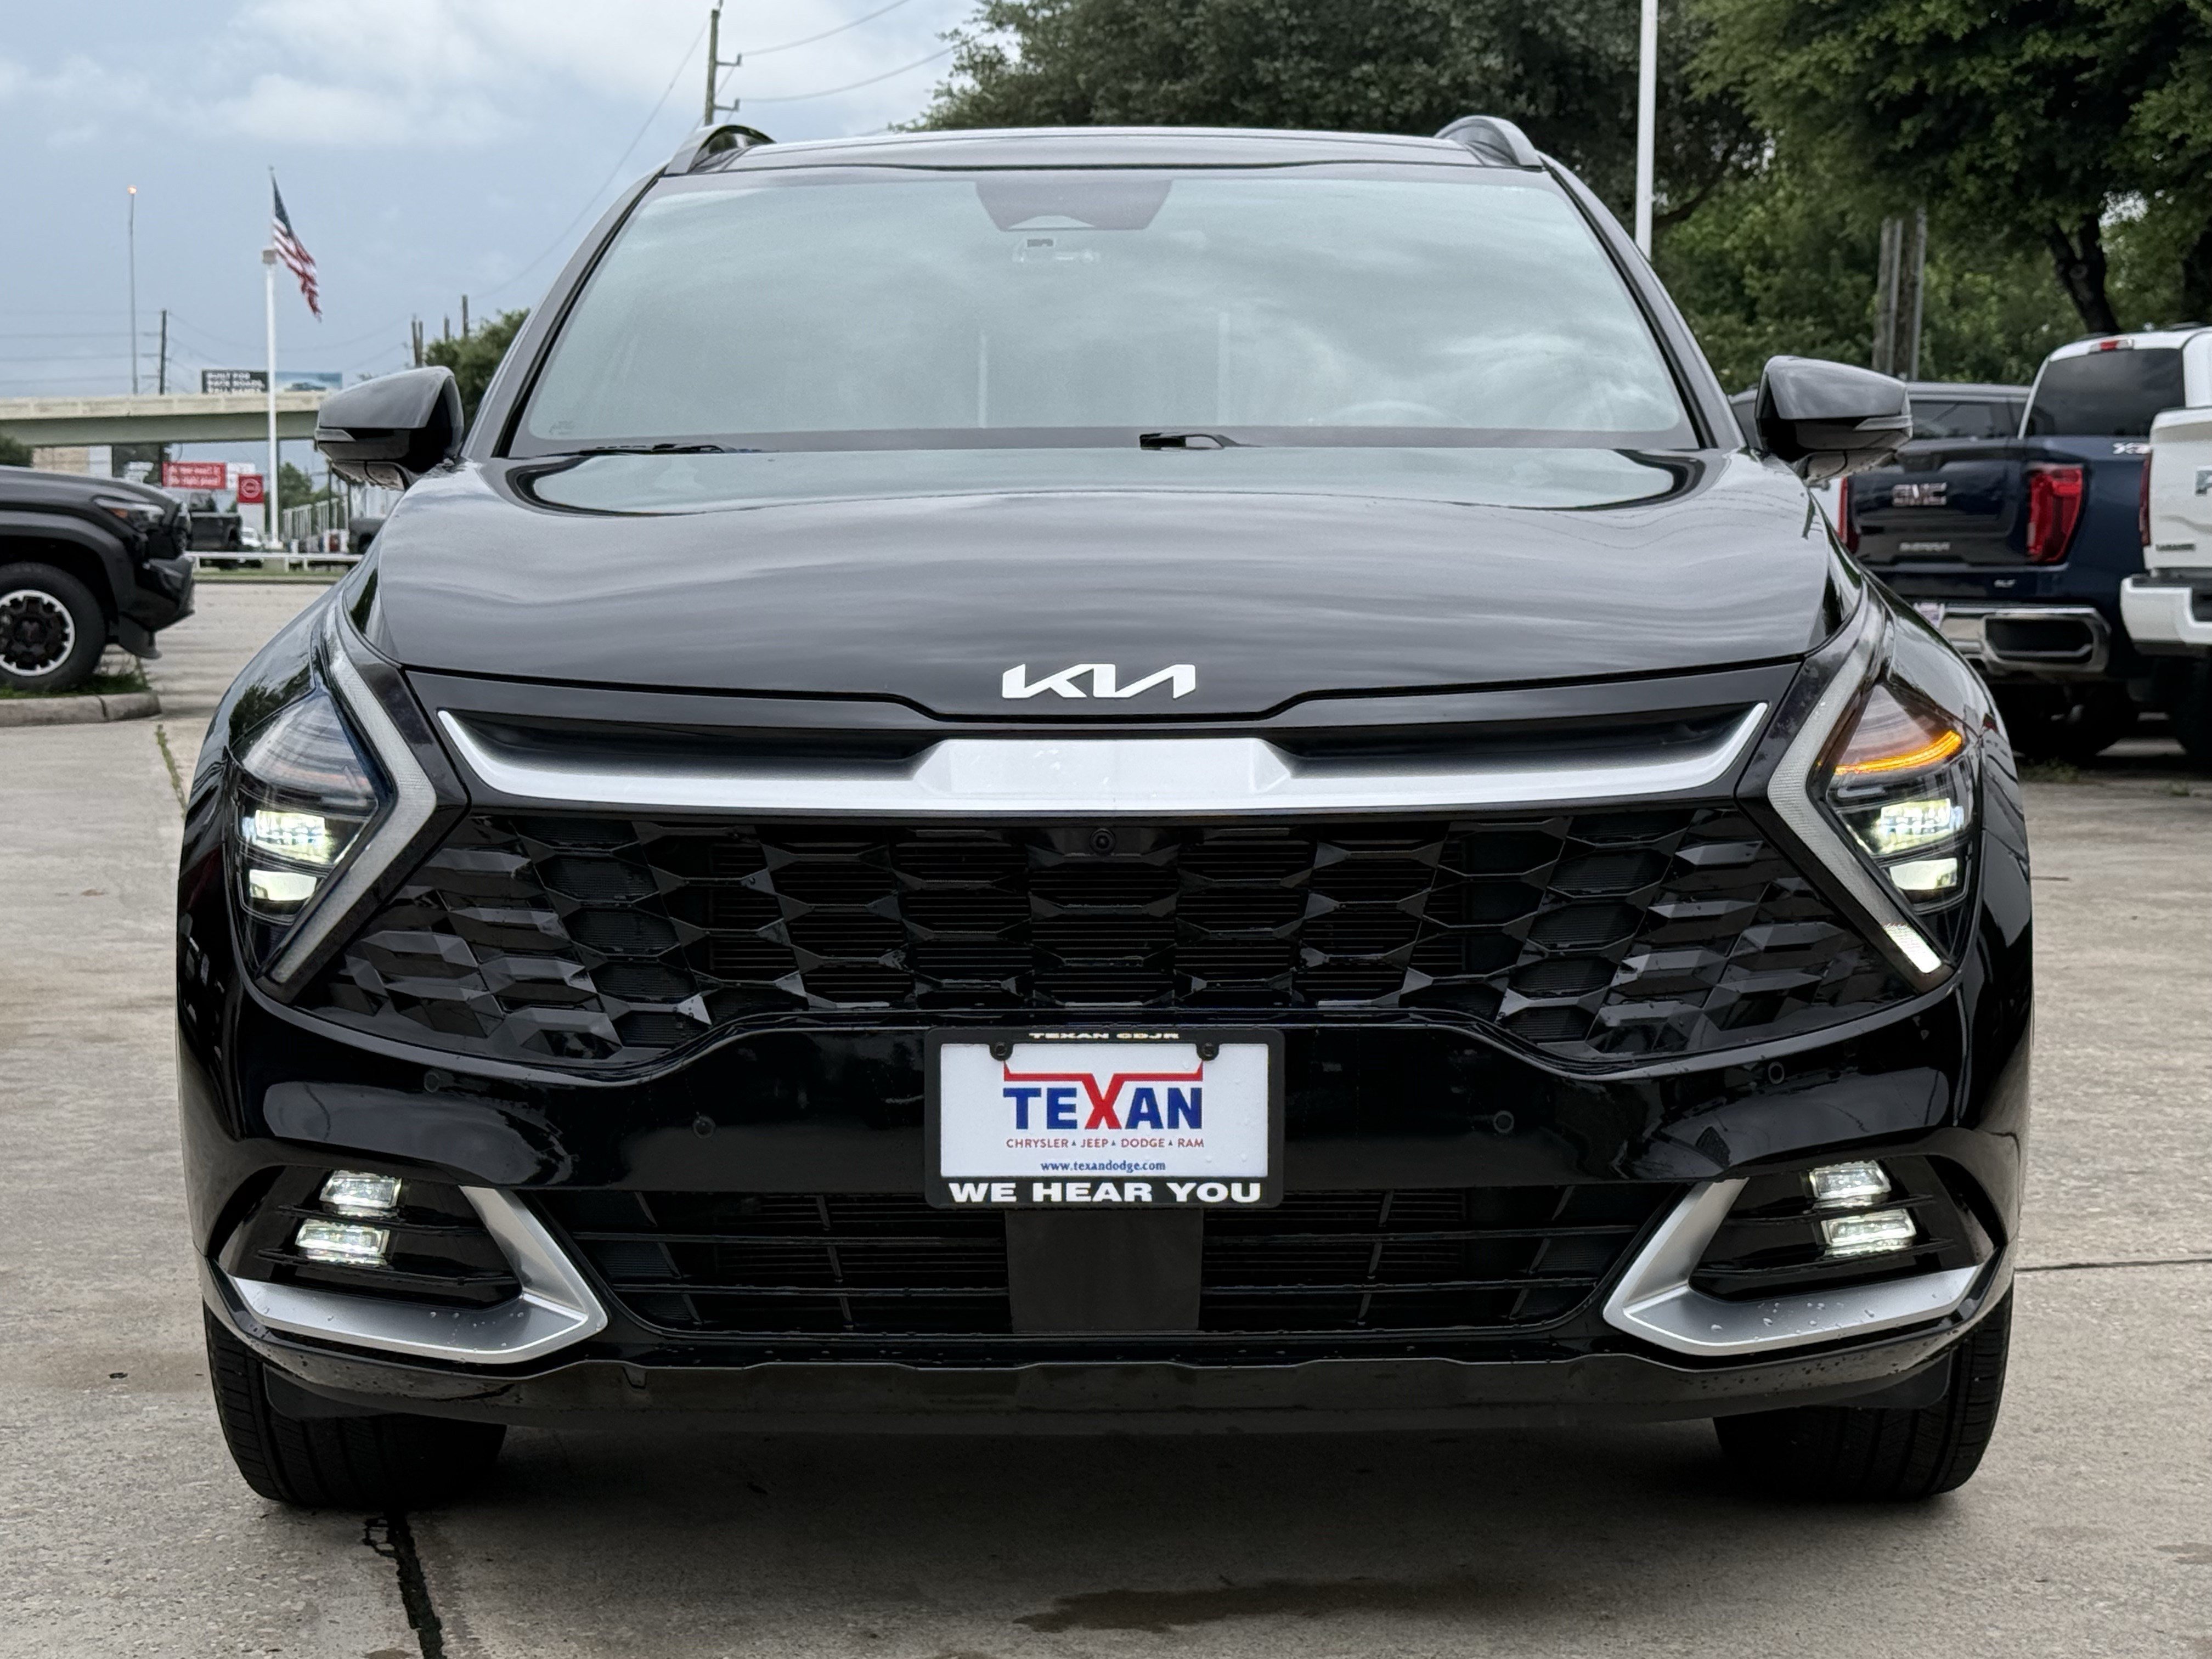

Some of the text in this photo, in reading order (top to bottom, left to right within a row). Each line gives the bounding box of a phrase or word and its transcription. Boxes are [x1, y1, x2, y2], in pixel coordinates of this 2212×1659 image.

[1891, 483, 1947, 505] GMC
[1003, 1074, 1203, 1130] TEXAN
[1006, 1138, 1205, 1148] CHRYSLER JEEP DODGE RAM
[1040, 1159, 1166, 1173] www.texandodge.com
[949, 1182, 1261, 1203] WE HEAR YOU
